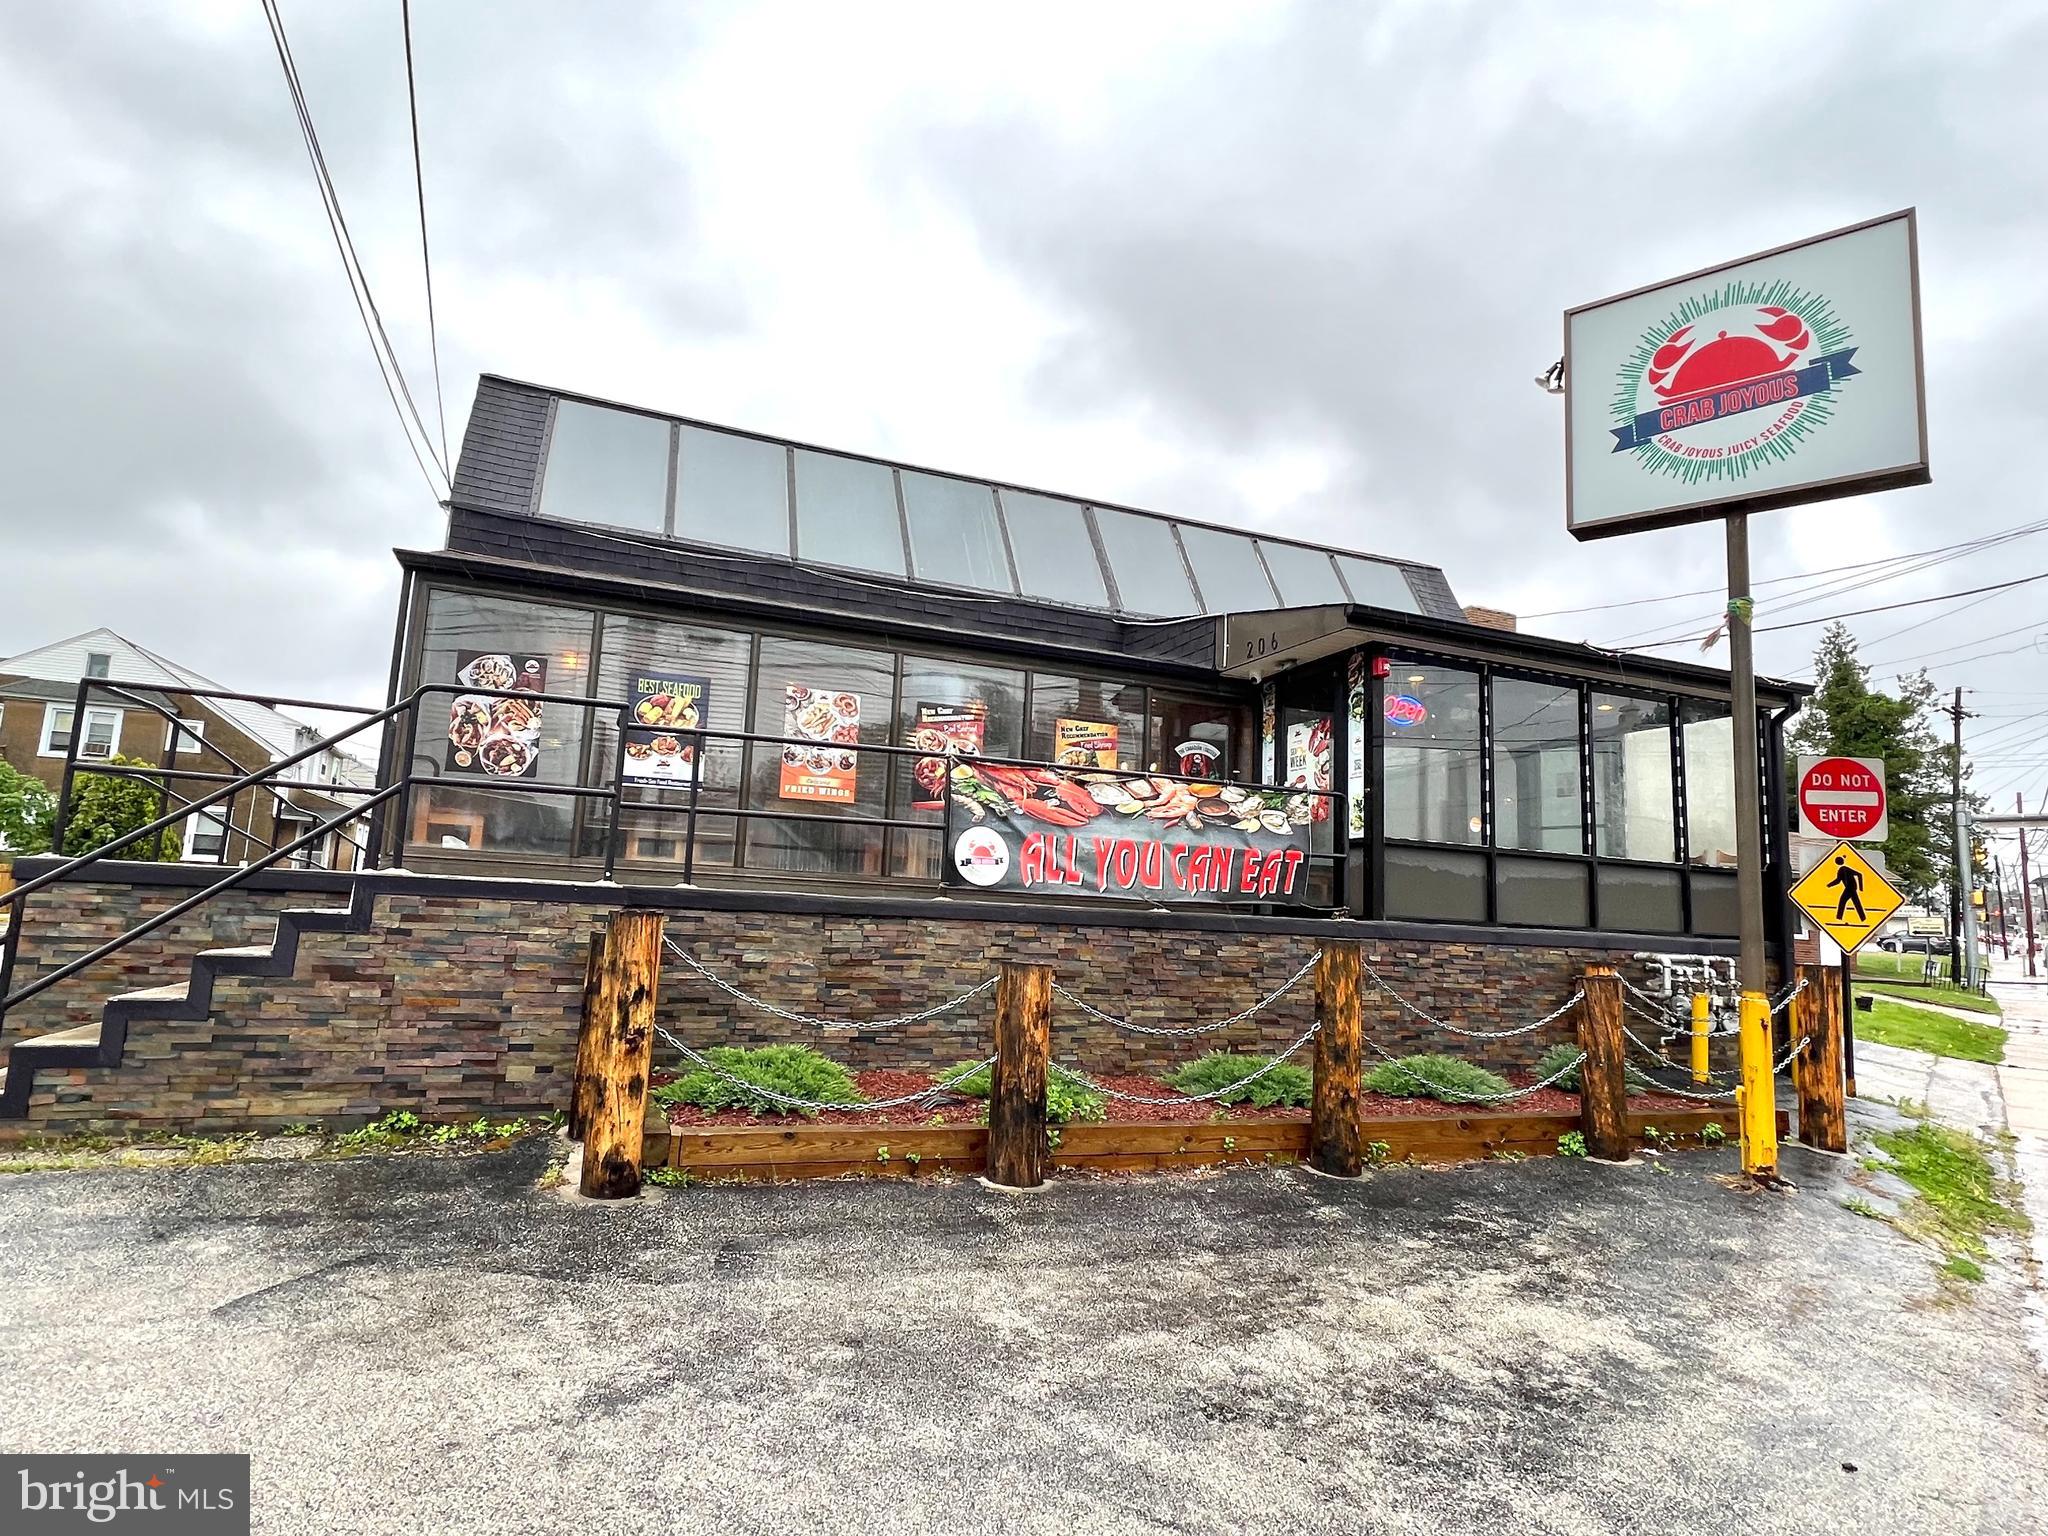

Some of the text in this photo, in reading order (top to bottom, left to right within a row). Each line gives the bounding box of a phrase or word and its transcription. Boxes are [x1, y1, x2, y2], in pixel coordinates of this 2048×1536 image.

[1660, 374, 1799, 431] CRAB JOYOUS
[1657, 400, 1804, 459] CRAB JOYOUS JUICY SEAFOOD
[1246, 632, 1278, 659] 206
[637, 678, 702, 699] BEST SEAFOOD
[1290, 755, 1307, 768] WEEK
[1812, 773, 1870, 787] DO NOT
[784, 784, 850, 798] FRIED WINGS
[1819, 809, 1867, 823] ENTER
[1020, 832, 1304, 898] ALL YOU CAN EAT
